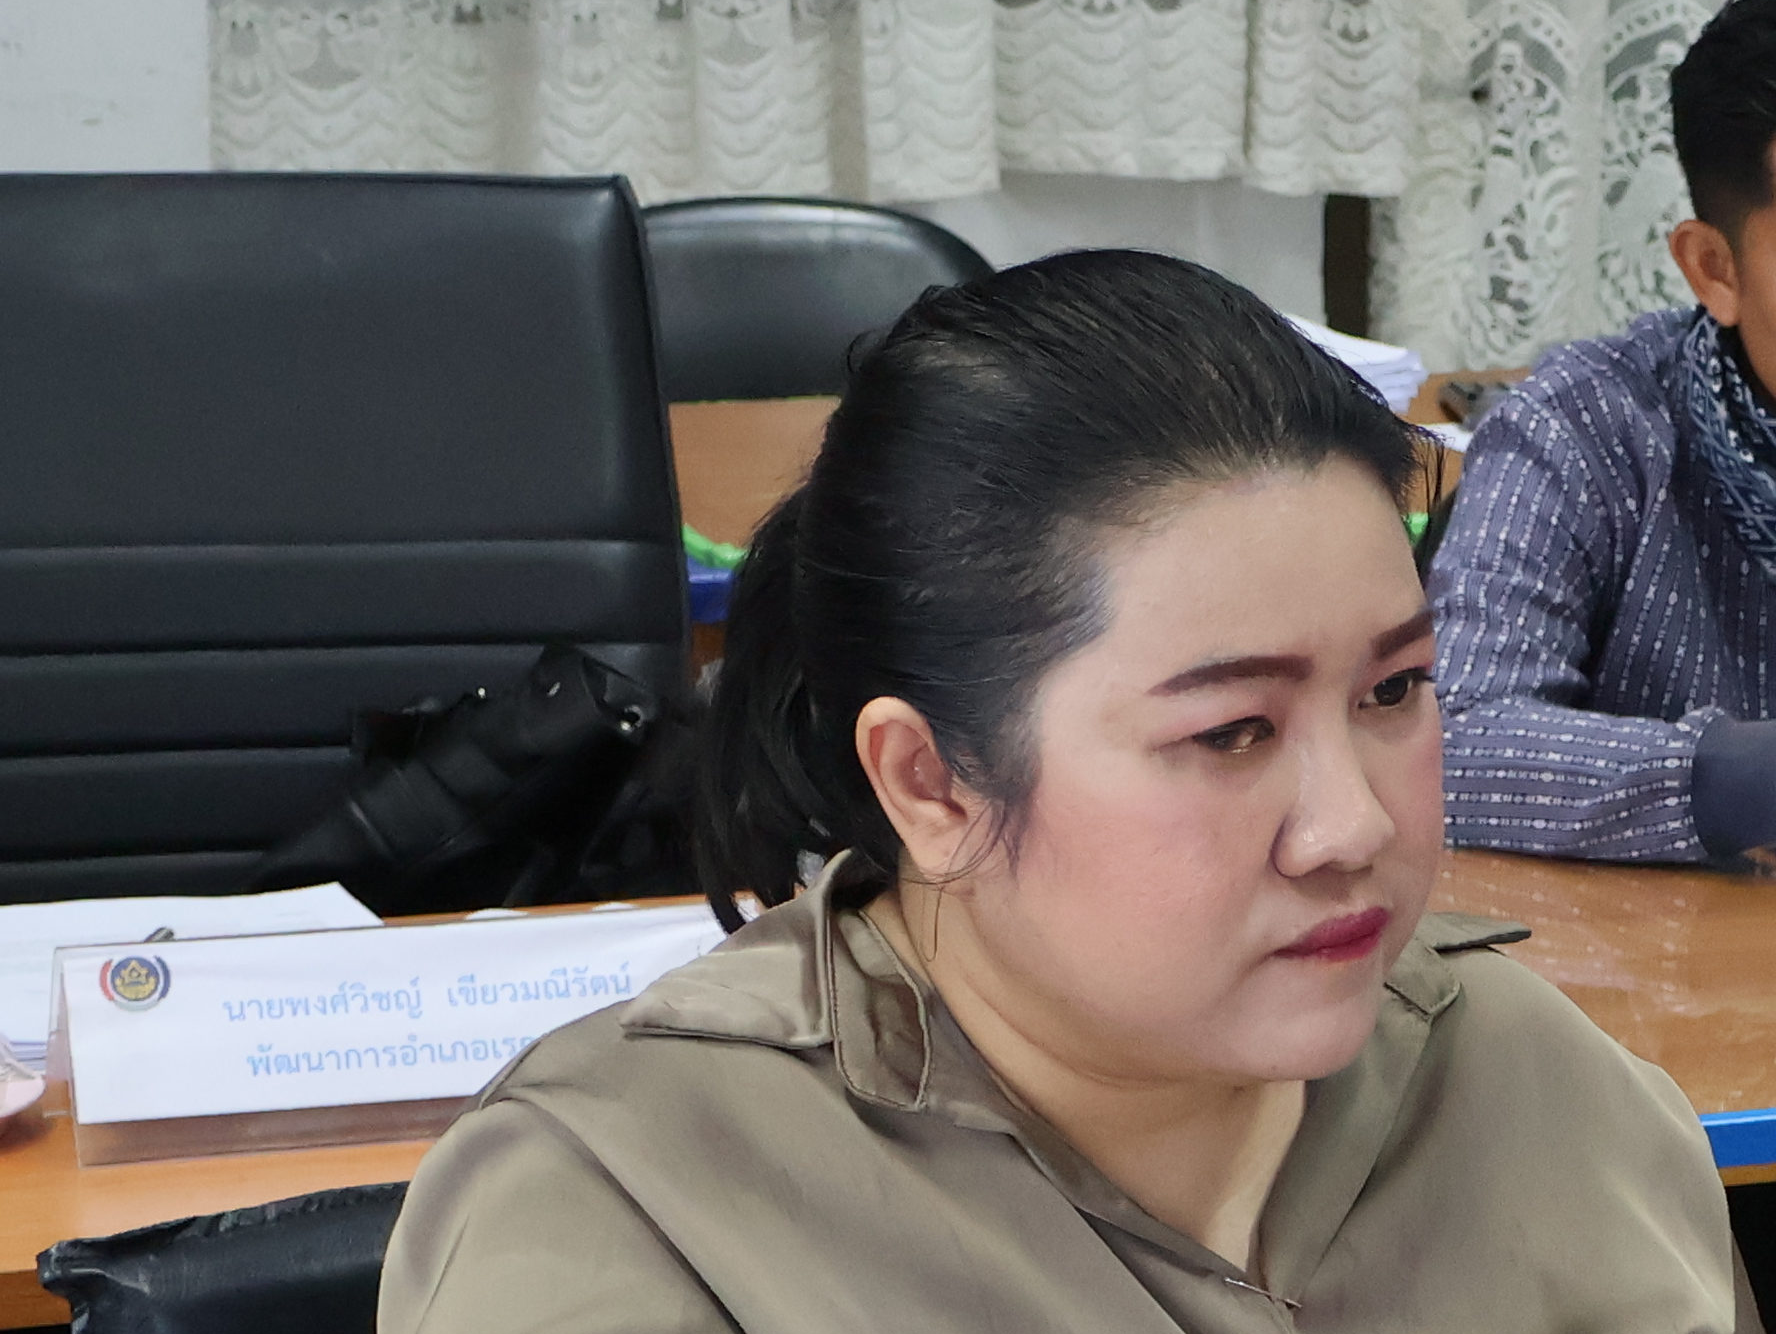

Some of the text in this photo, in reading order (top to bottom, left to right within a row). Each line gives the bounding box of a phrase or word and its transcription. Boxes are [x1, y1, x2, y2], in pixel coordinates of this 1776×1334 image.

[222, 961, 632, 1023] นายพงศ์วิชญ์ เขียวมณีรัตน์
